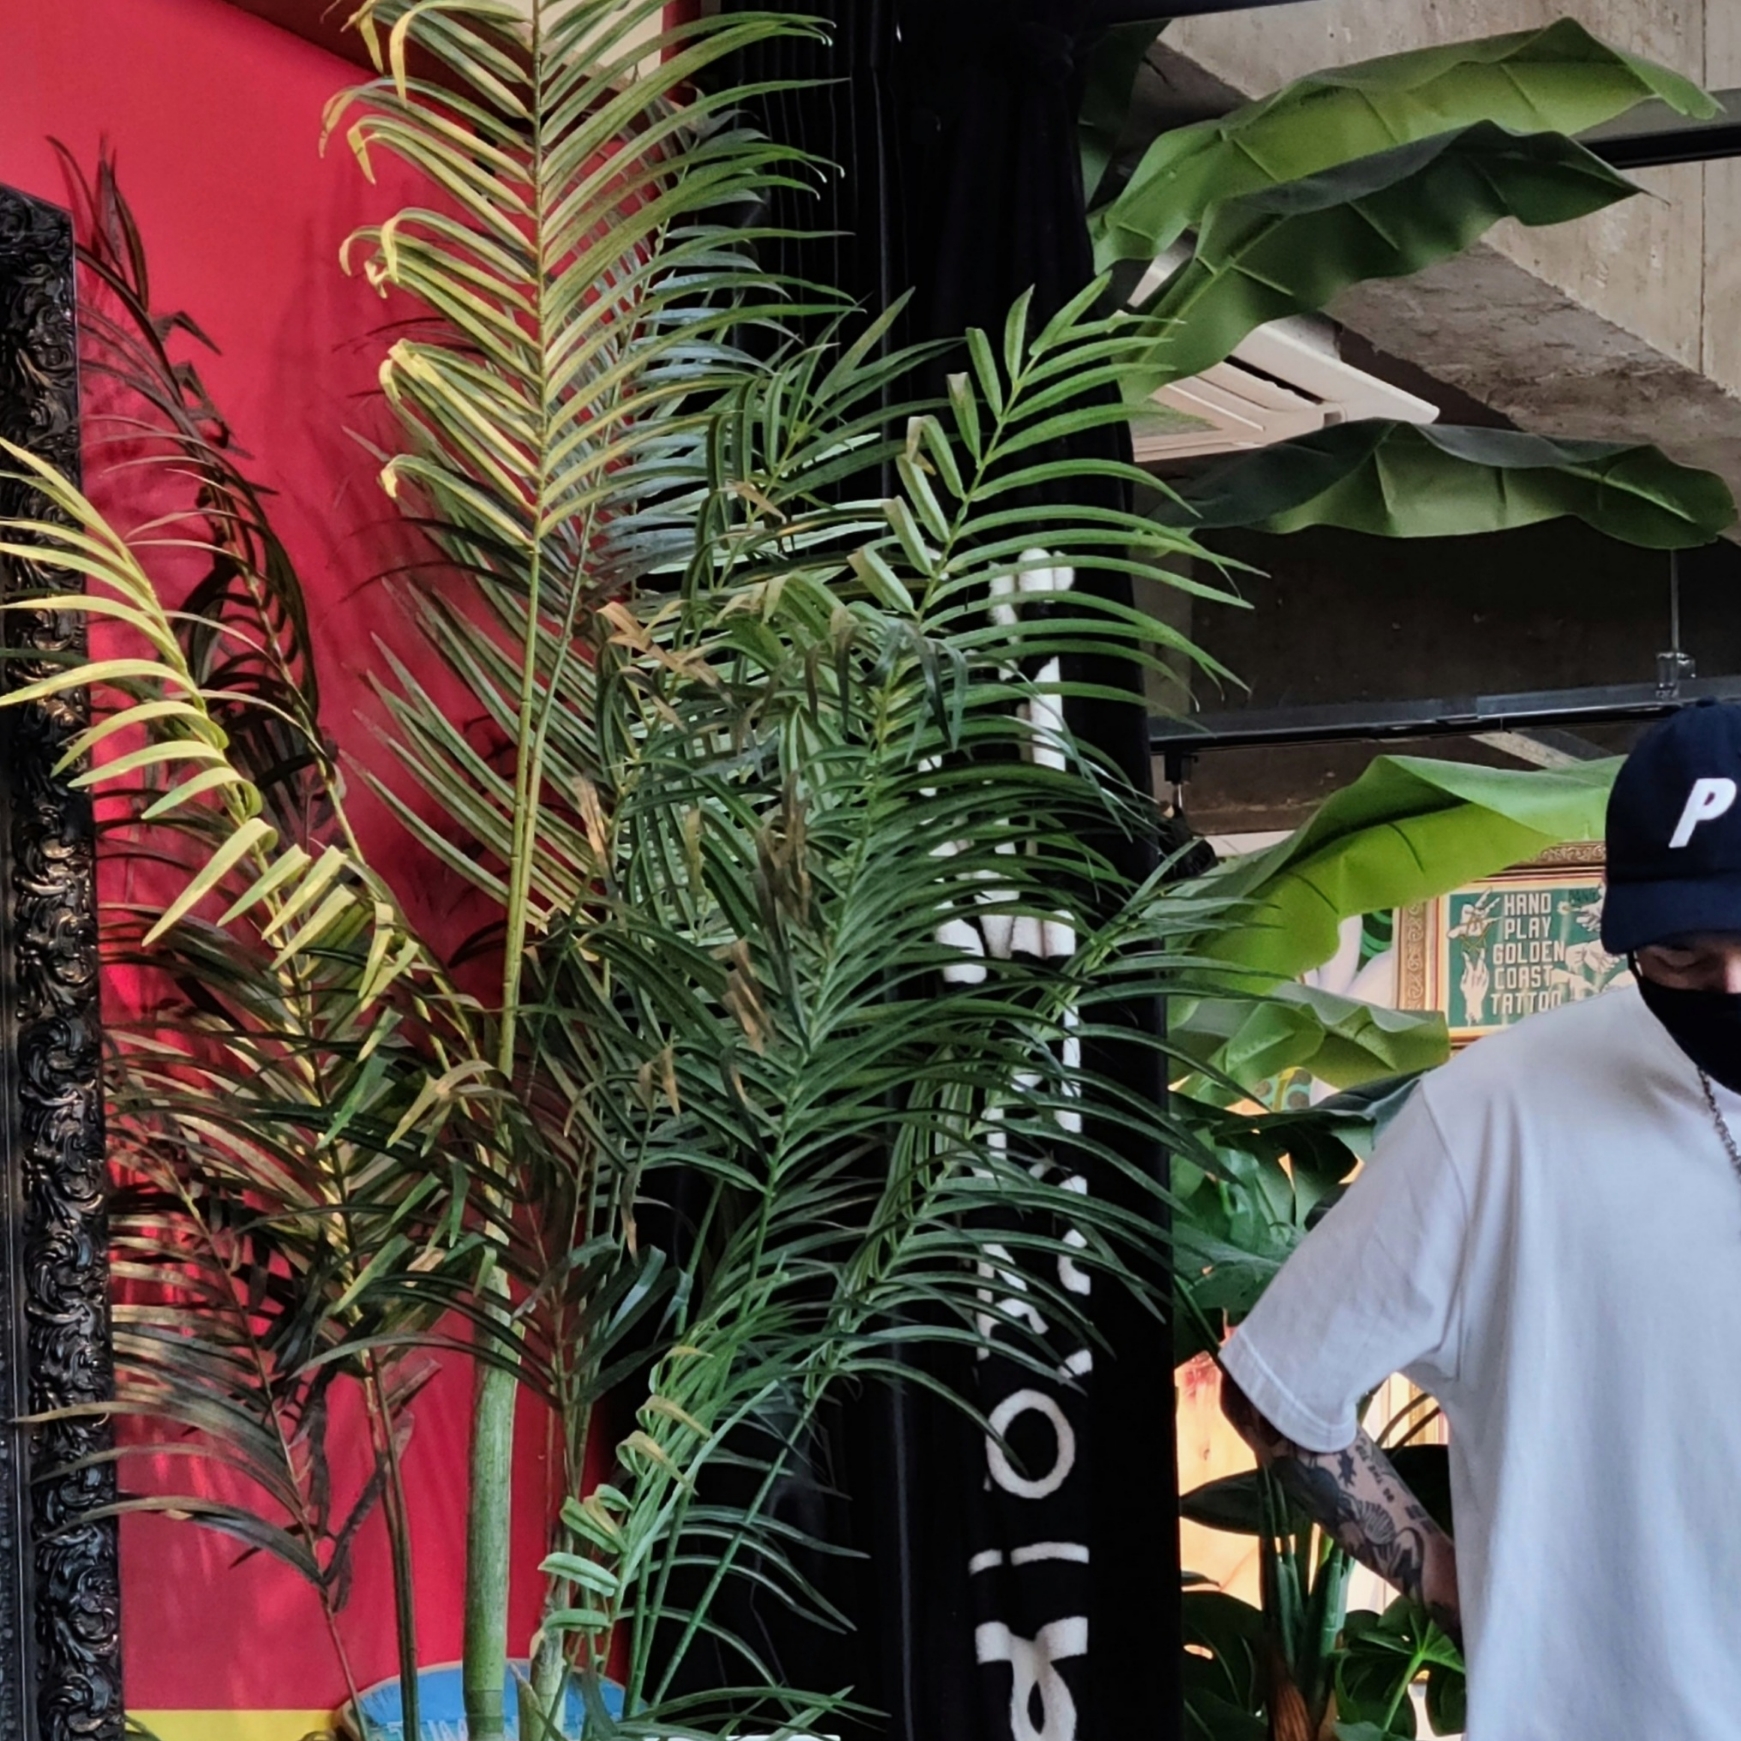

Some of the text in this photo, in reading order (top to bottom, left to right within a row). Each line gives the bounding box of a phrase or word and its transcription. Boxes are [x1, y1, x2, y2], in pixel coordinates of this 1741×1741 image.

[1669, 778, 1737, 848] P
[1504, 893, 1551, 916] HAND
[1504, 917, 1551, 940] PLAY
[1493, 940, 1565, 965] GOLDEN
[1495, 965, 1553, 989] COAST
[1490, 990, 1561, 1015] TATTOO
